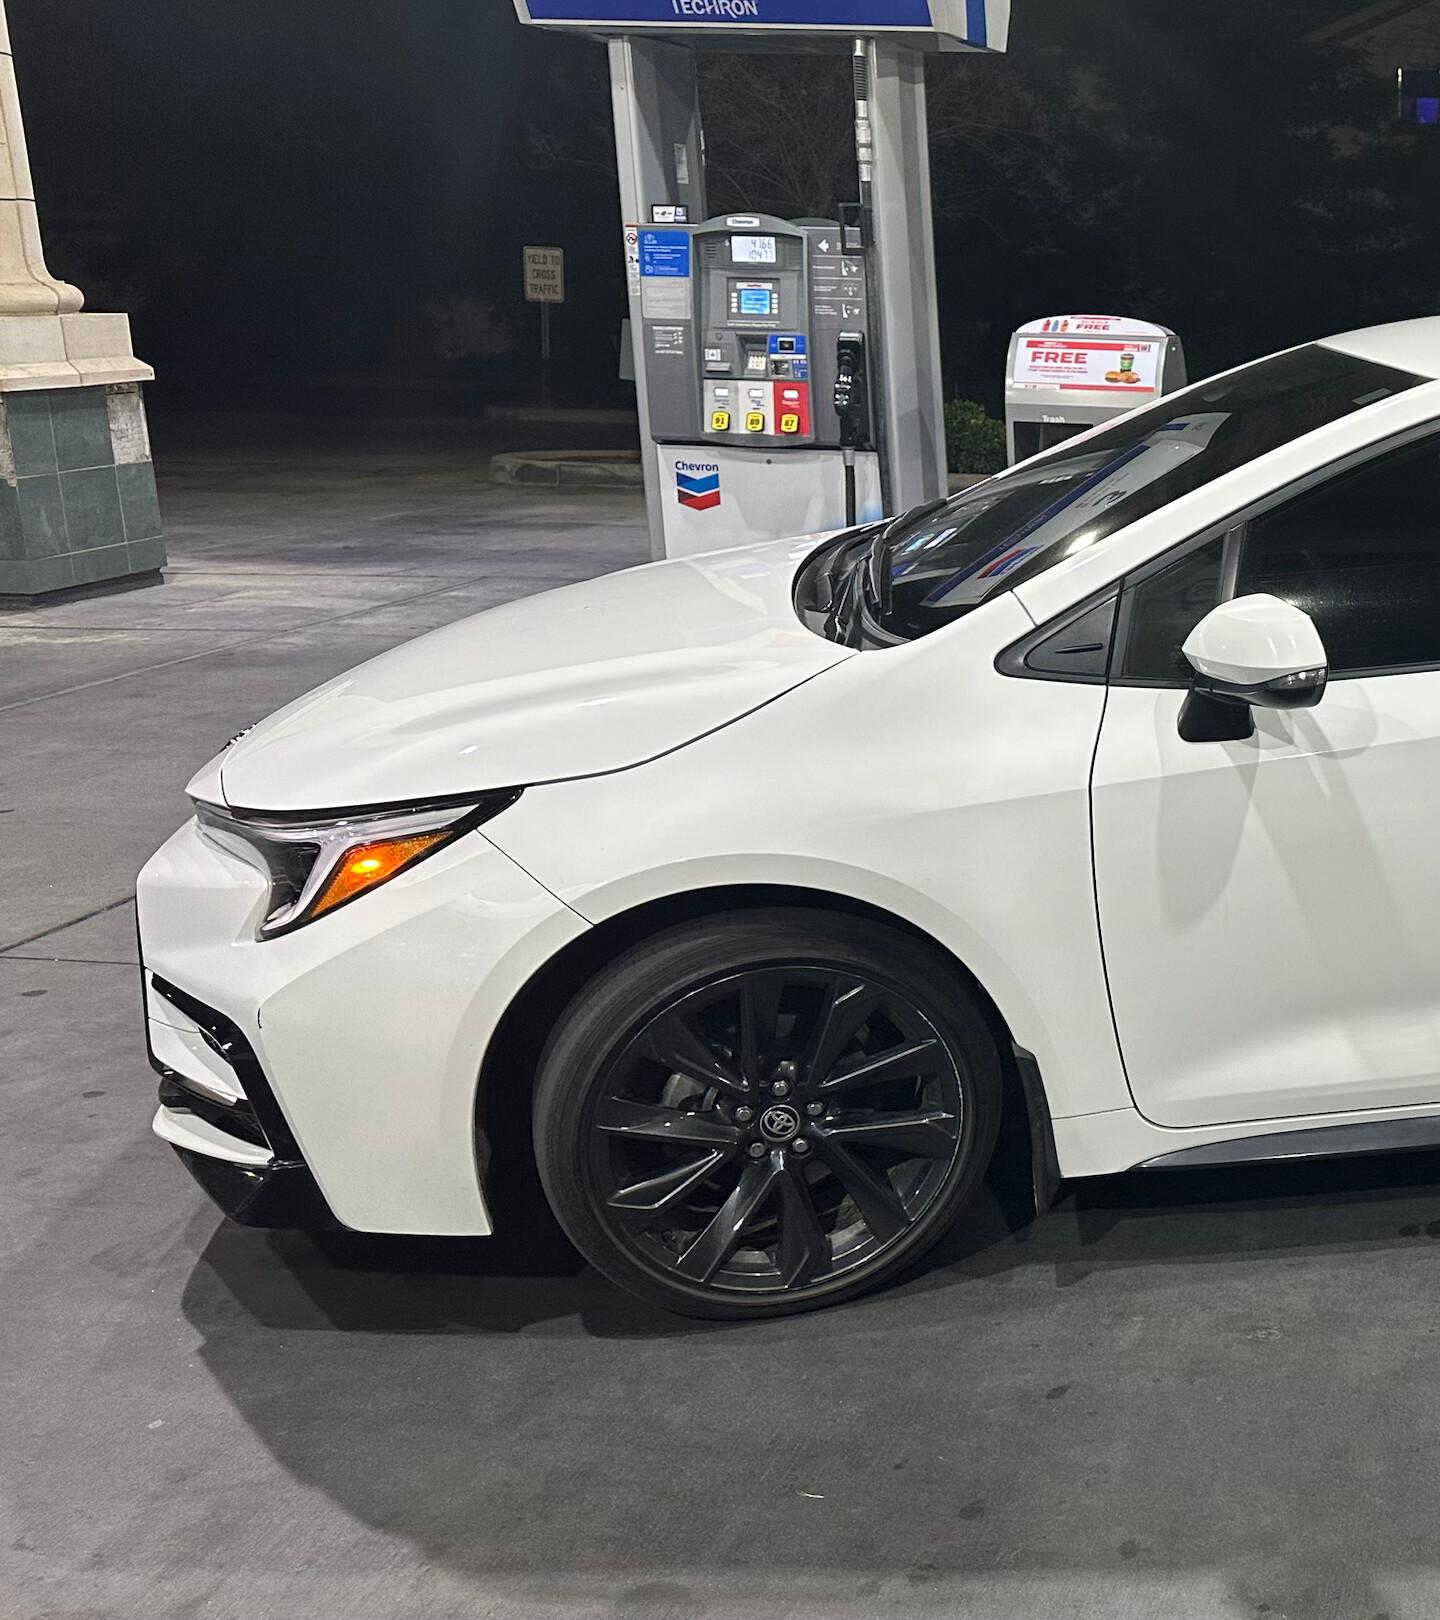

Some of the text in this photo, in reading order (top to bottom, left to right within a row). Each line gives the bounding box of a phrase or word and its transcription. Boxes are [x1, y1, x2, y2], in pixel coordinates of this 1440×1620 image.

[528, 254, 560, 266] YIELD TO
[532, 269, 556, 281] CROSS
[529, 283, 560, 296] TRAFFIC
[1075, 323, 1111, 331] FREE
[1031, 351, 1088, 364] FREE
[714, 417, 725, 425] 91
[750, 418, 760, 426] 89
[784, 419, 795, 427] 87
[1041, 414, 1065, 424] Trash
[675, 461, 719, 471] Chevron
